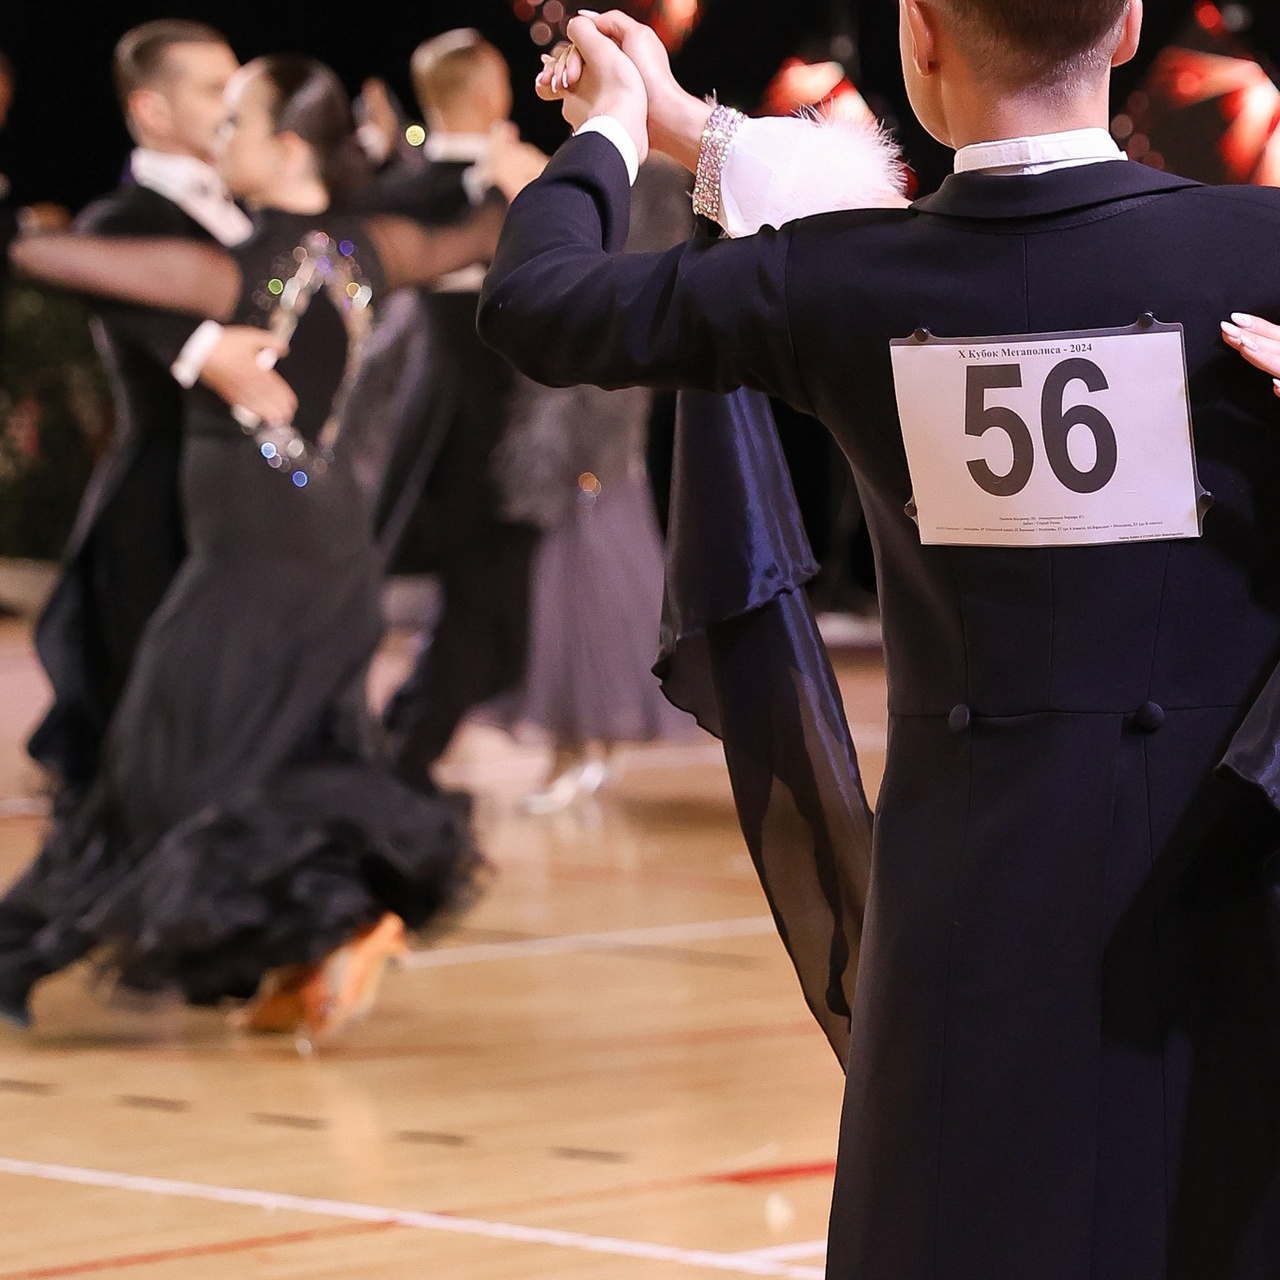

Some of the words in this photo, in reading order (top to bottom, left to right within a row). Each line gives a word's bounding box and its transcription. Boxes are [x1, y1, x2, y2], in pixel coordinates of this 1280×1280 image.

[969, 349, 999, 360] Кубок
[1001, 346, 1061, 358] Мегаполиса
[1070, 343, 1093, 353] 2024
[964, 357, 1118, 497] 56
